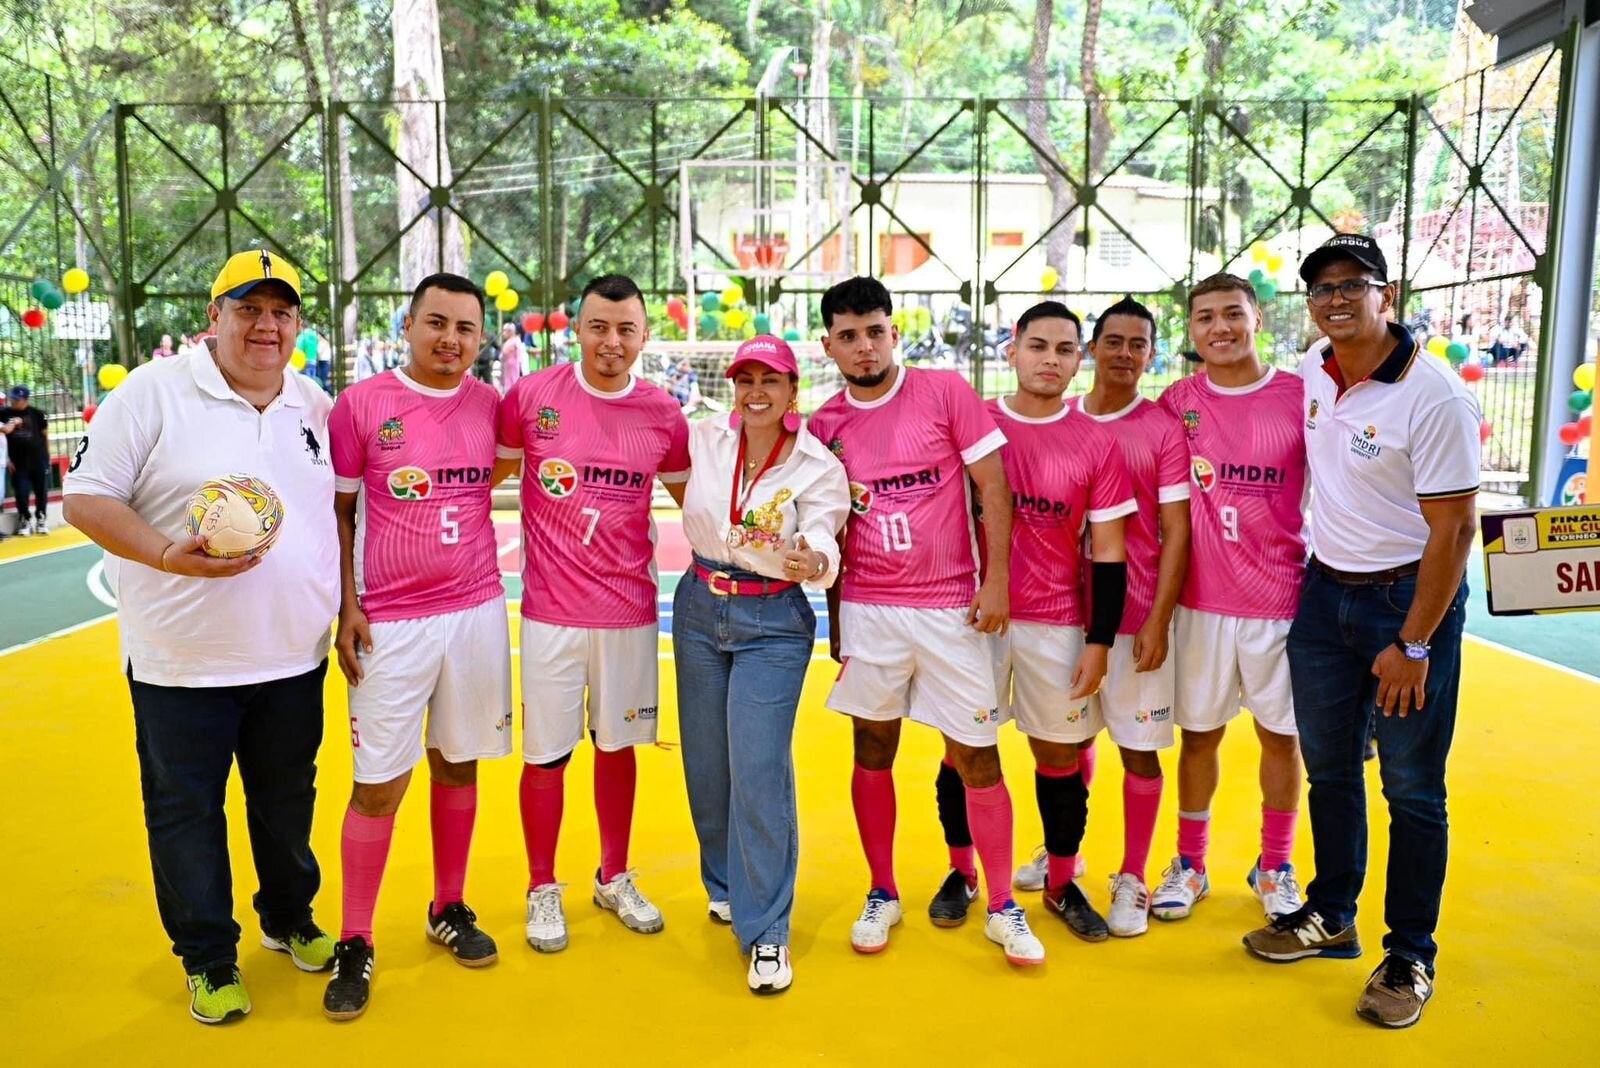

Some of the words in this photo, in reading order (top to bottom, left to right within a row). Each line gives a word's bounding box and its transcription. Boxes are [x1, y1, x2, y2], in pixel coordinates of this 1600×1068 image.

[68, 435, 89, 473] 3
[1352, 433, 1381, 456] IMDRI
[583, 466, 649, 488] IMDRI
[873, 466, 941, 494] IMDRI
[1220, 463, 1286, 484] IMDRI
[1012, 491, 1072, 517] IMDRI
[440, 506, 459, 545] 5
[581, 507, 601, 546] 7
[876, 512, 912, 553] 10
[1221, 505, 1238, 542] 9
[1551, 525, 1576, 534] MIL
[1555, 533, 1598, 541] TORNEO
